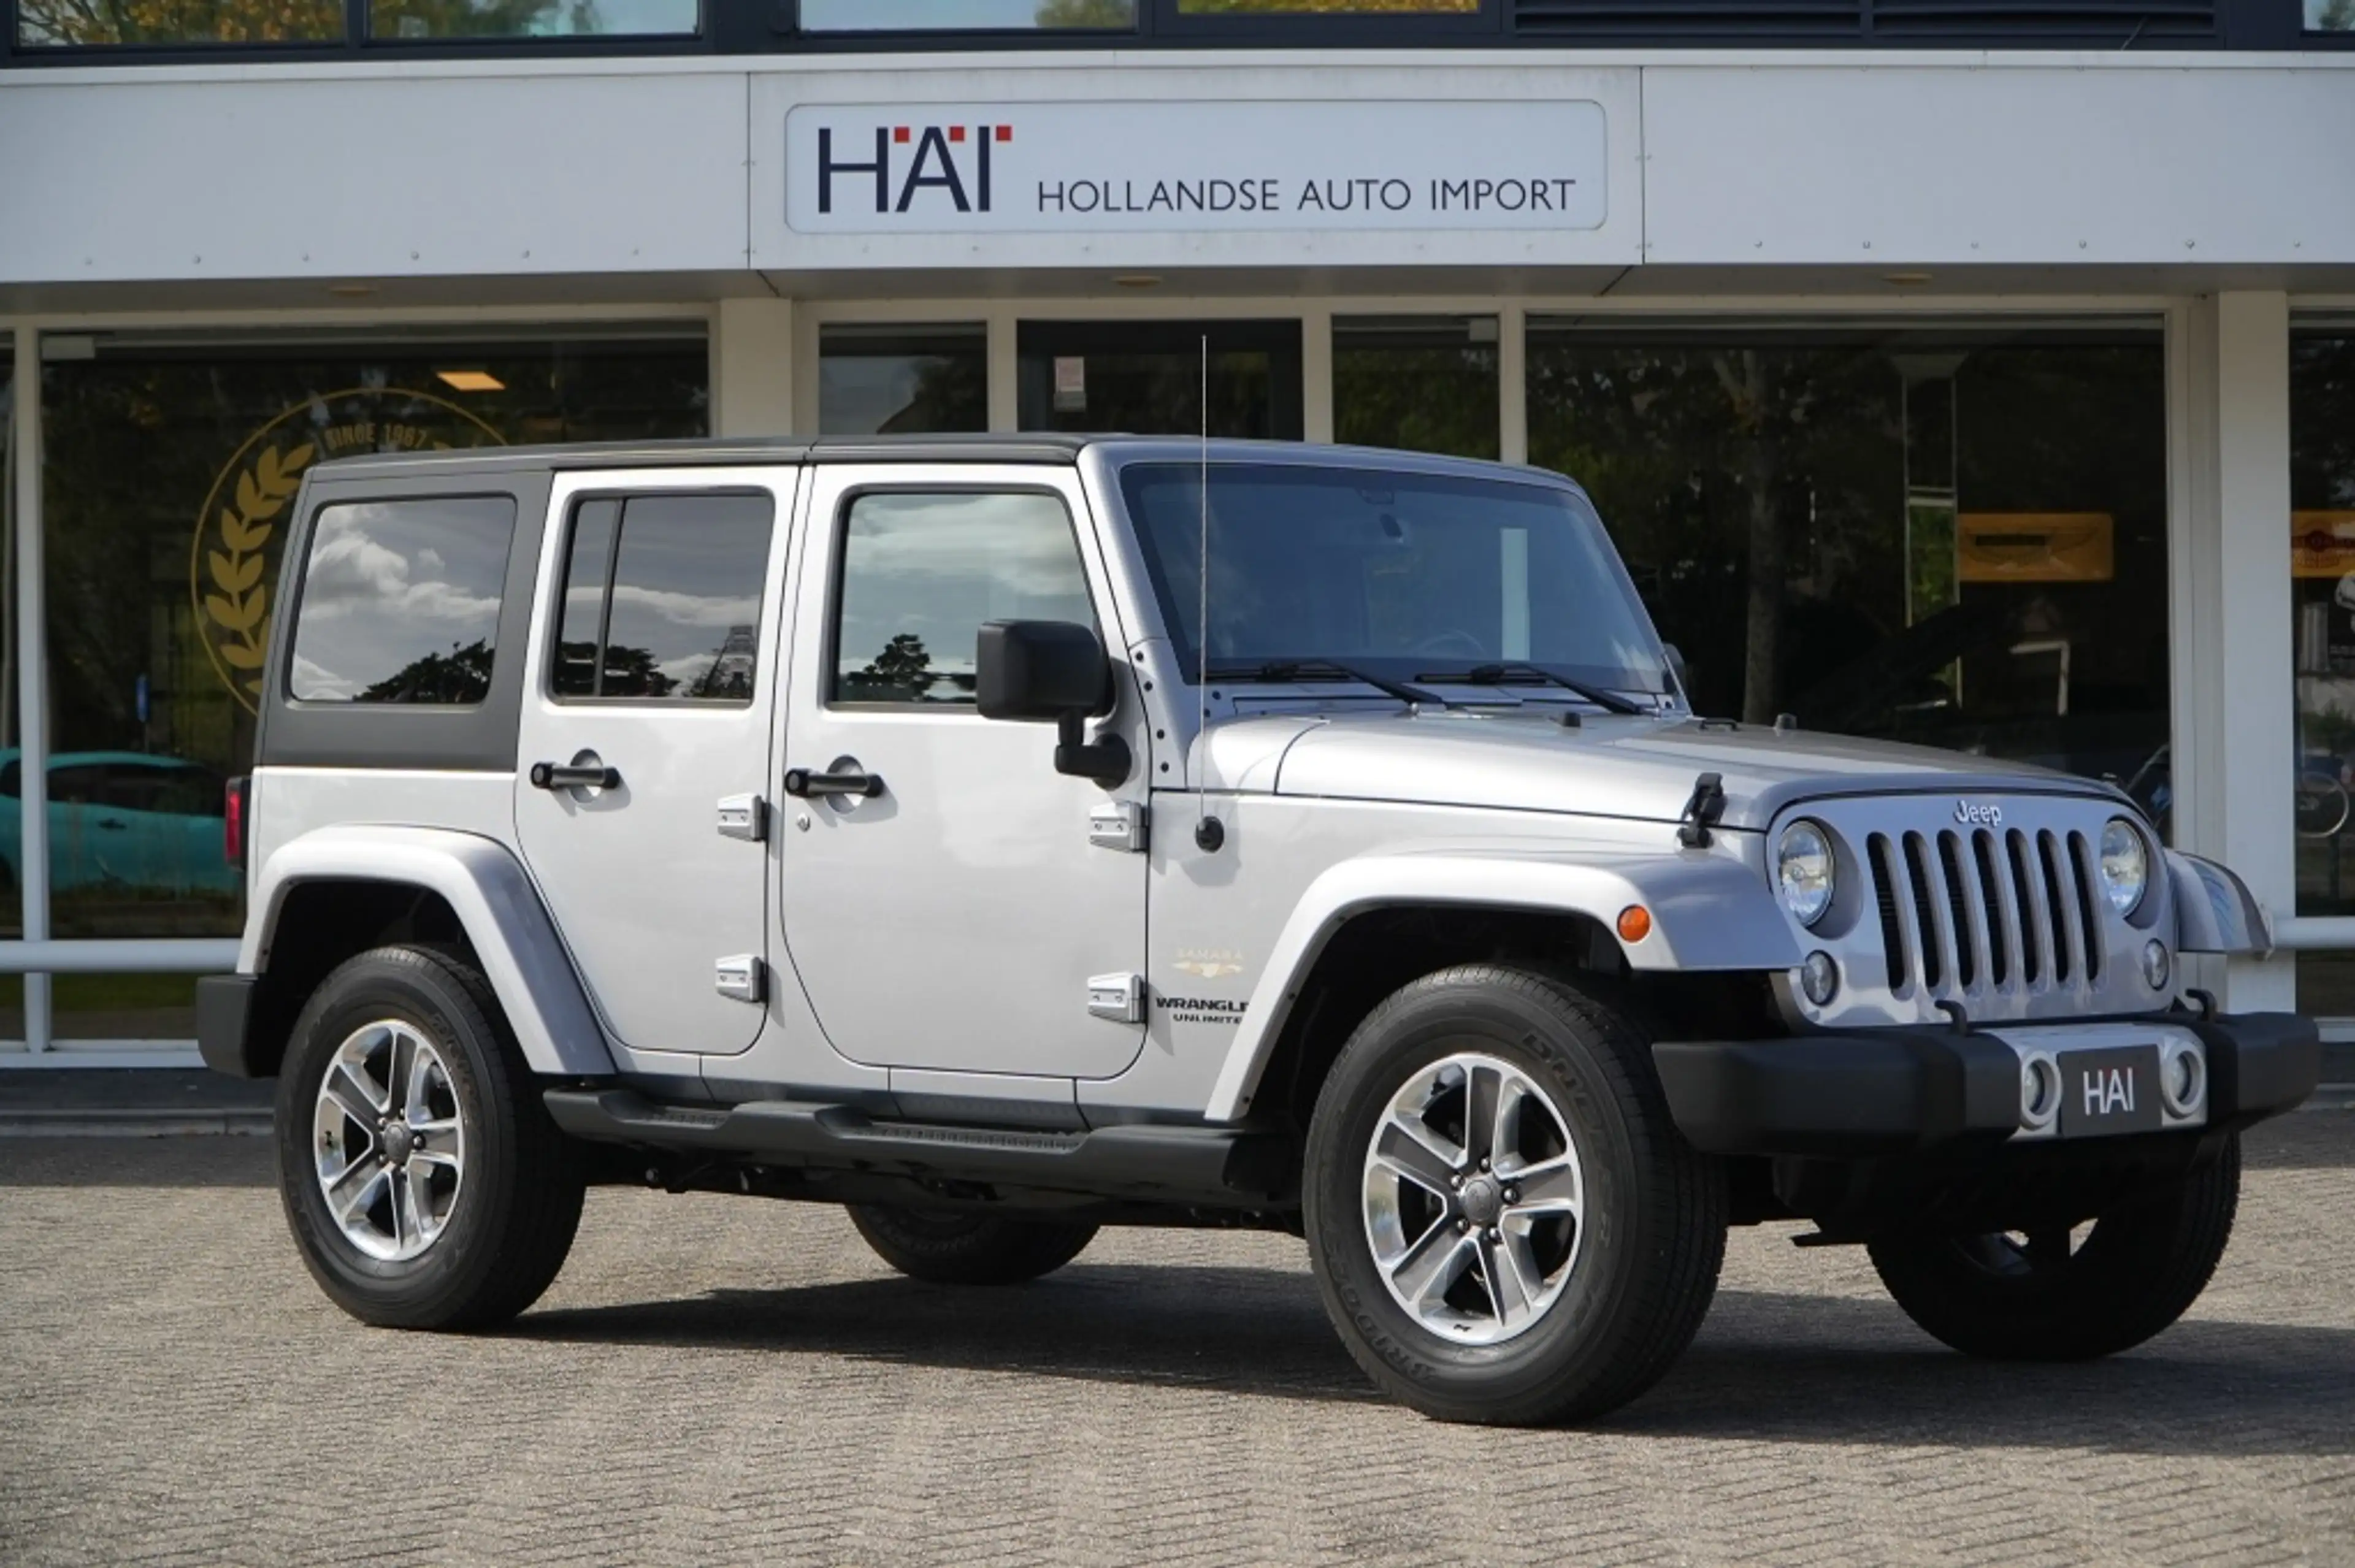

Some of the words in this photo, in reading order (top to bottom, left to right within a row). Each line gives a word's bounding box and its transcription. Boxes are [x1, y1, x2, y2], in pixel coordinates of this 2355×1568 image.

[1039, 179, 1279, 212] HOLLANDSE
[1297, 179, 1411, 210] AUTO
[1431, 179, 1576, 210] IMPORT
[324, 423, 377, 451] SINCE
[1953, 800, 2002, 828] Jeep
[2083, 1067, 2135, 1116] HAI
